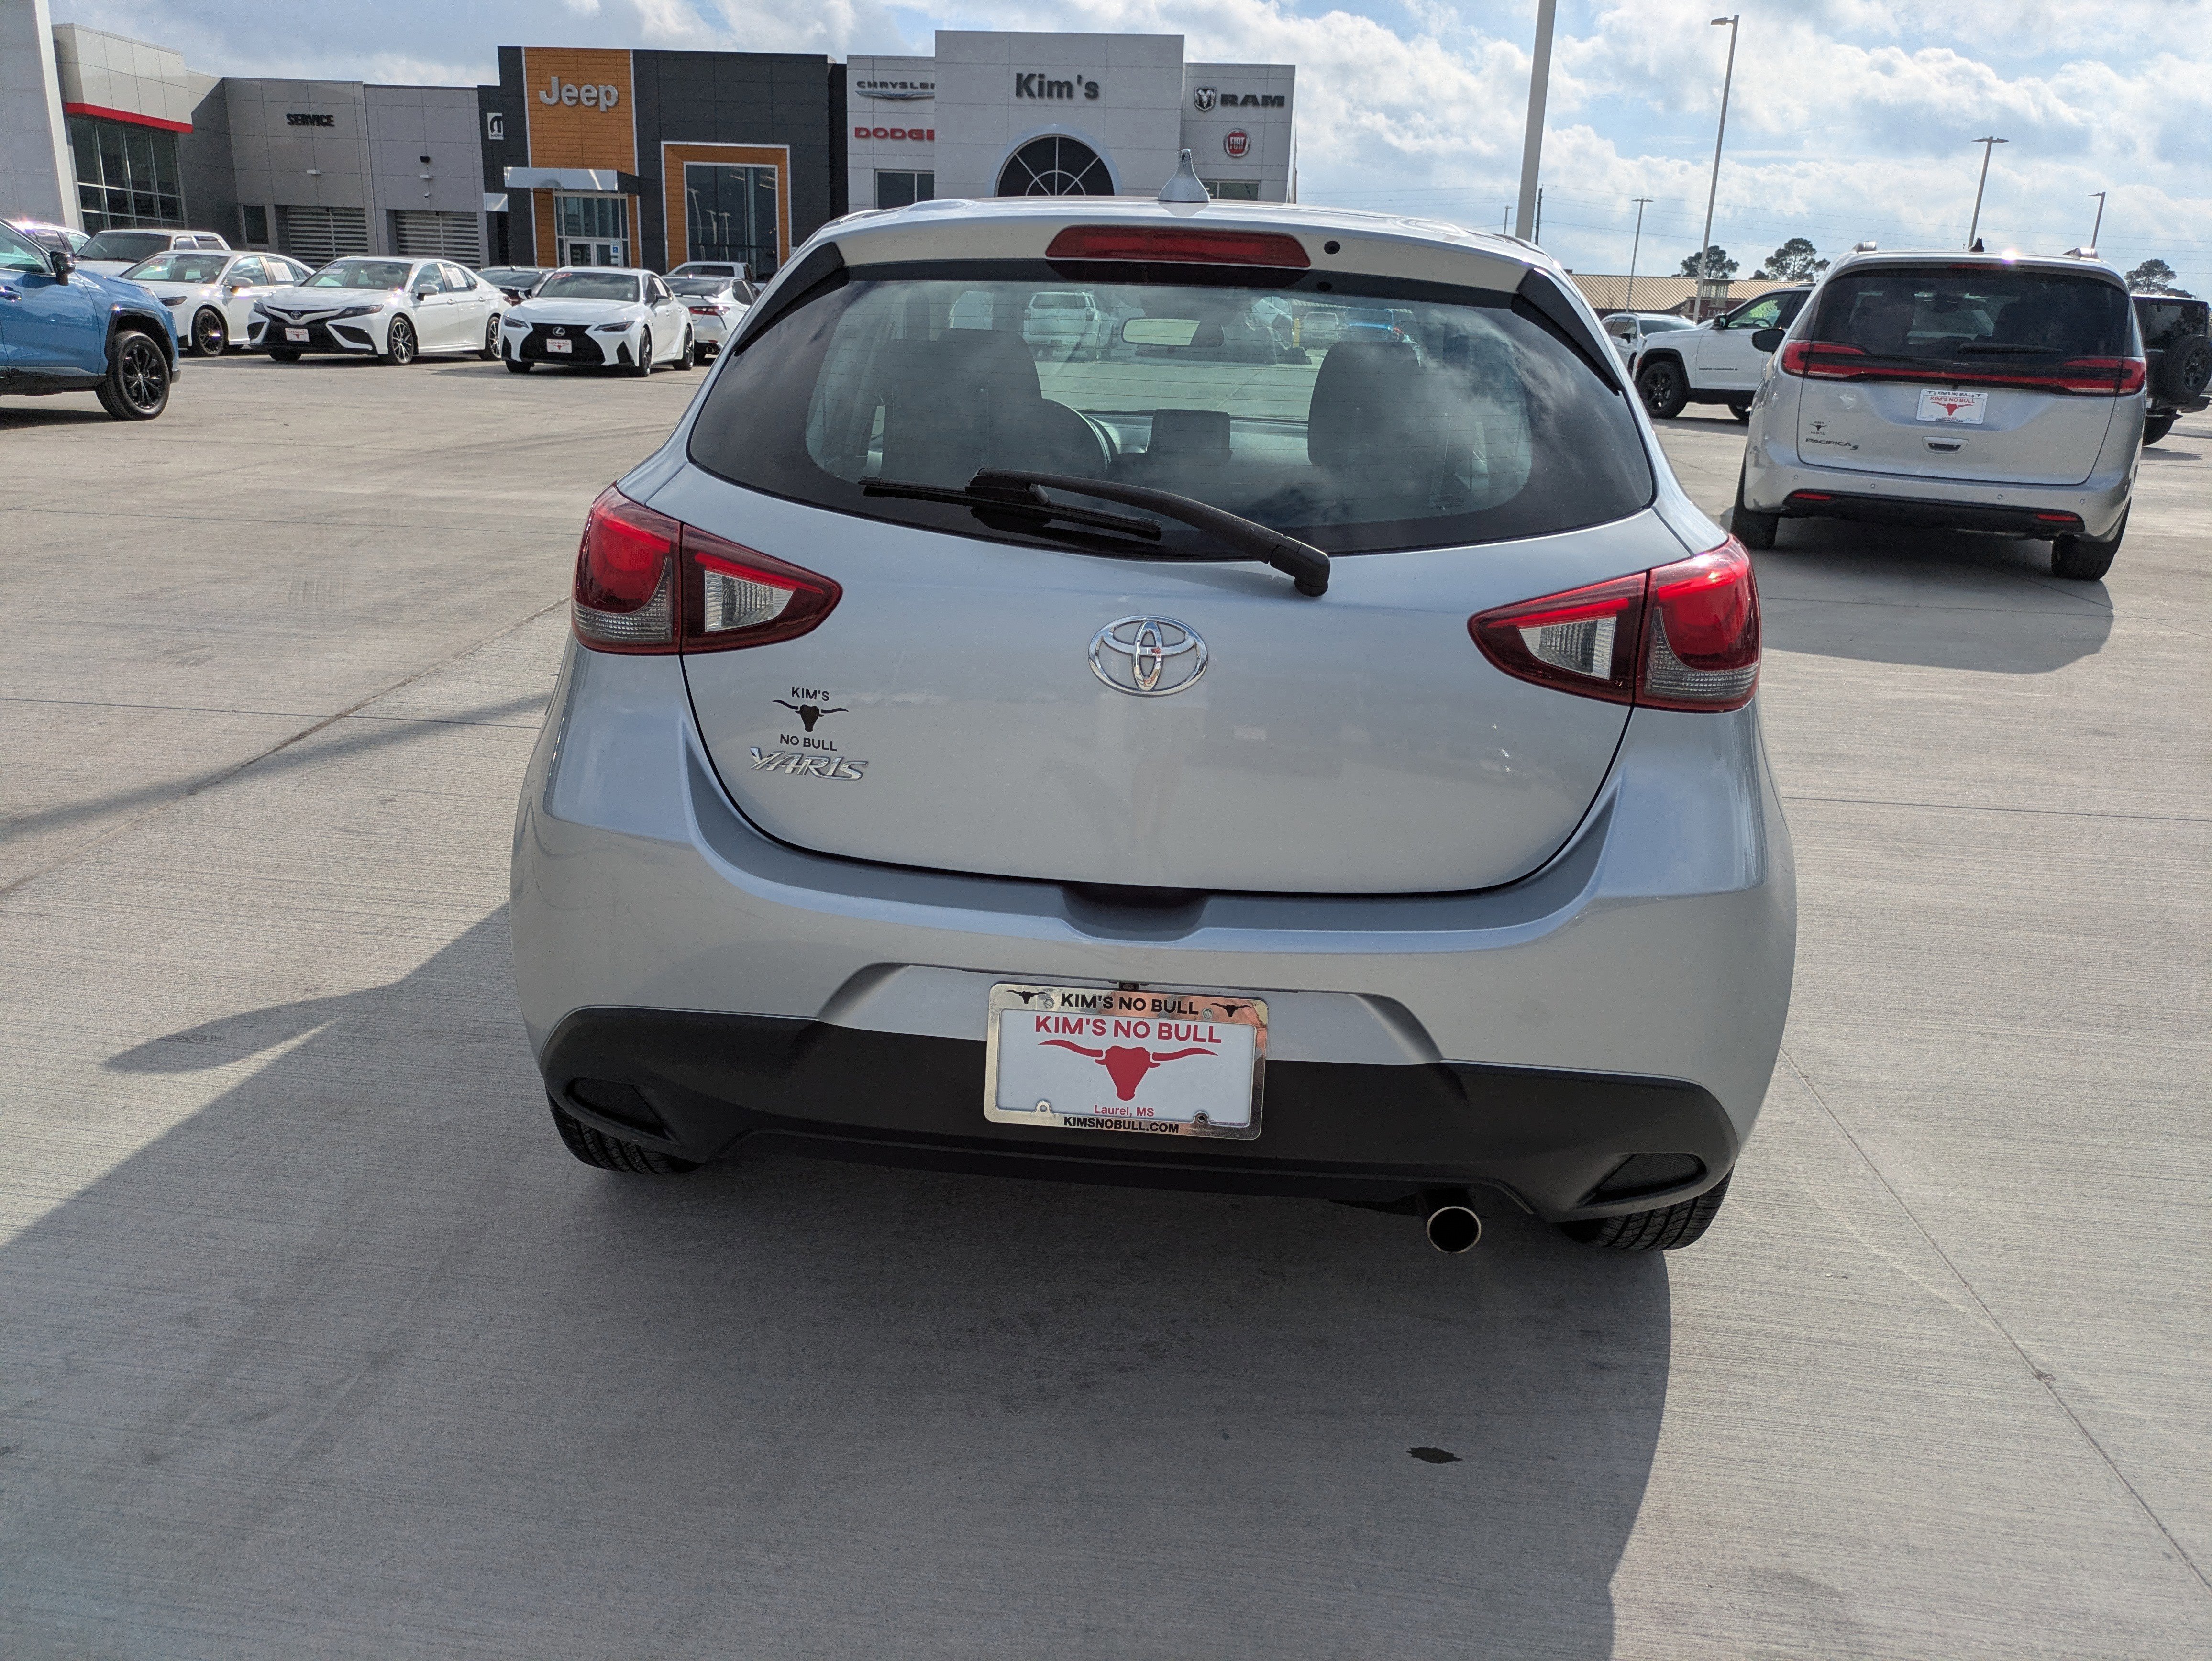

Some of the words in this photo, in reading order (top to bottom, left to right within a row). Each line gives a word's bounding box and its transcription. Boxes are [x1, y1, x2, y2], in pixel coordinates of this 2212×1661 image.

[539, 76, 619, 112] Jeep
[1016, 73, 1099, 100] Kim's
[1220, 94, 1285, 107] RAM
[286, 113, 335, 127] SERVICE
[1229, 137, 1245, 150] FIAT
[1805, 438, 1851, 447] PACIFICA
[791, 687, 830, 701] KIM'S
[780, 734, 800, 746] NO
[803, 737, 838, 752] BULL
[750, 746, 869, 782] YARIS
[1060, 993, 1115, 1010] KIM'S
[1118, 996, 1147, 1012] NO
[1151, 998, 1199, 1016] BULL
[1034, 1015, 1106, 1037] KIM'S
[1113, 1019, 1150, 1039] NO
[1157, 1022, 1222, 1044] BULL
[1094, 1104, 1133, 1117] Laurel,
[1136, 1107, 1154, 1117] MS
[1063, 1116, 1180, 1134] KIMSNOBULL.COM
